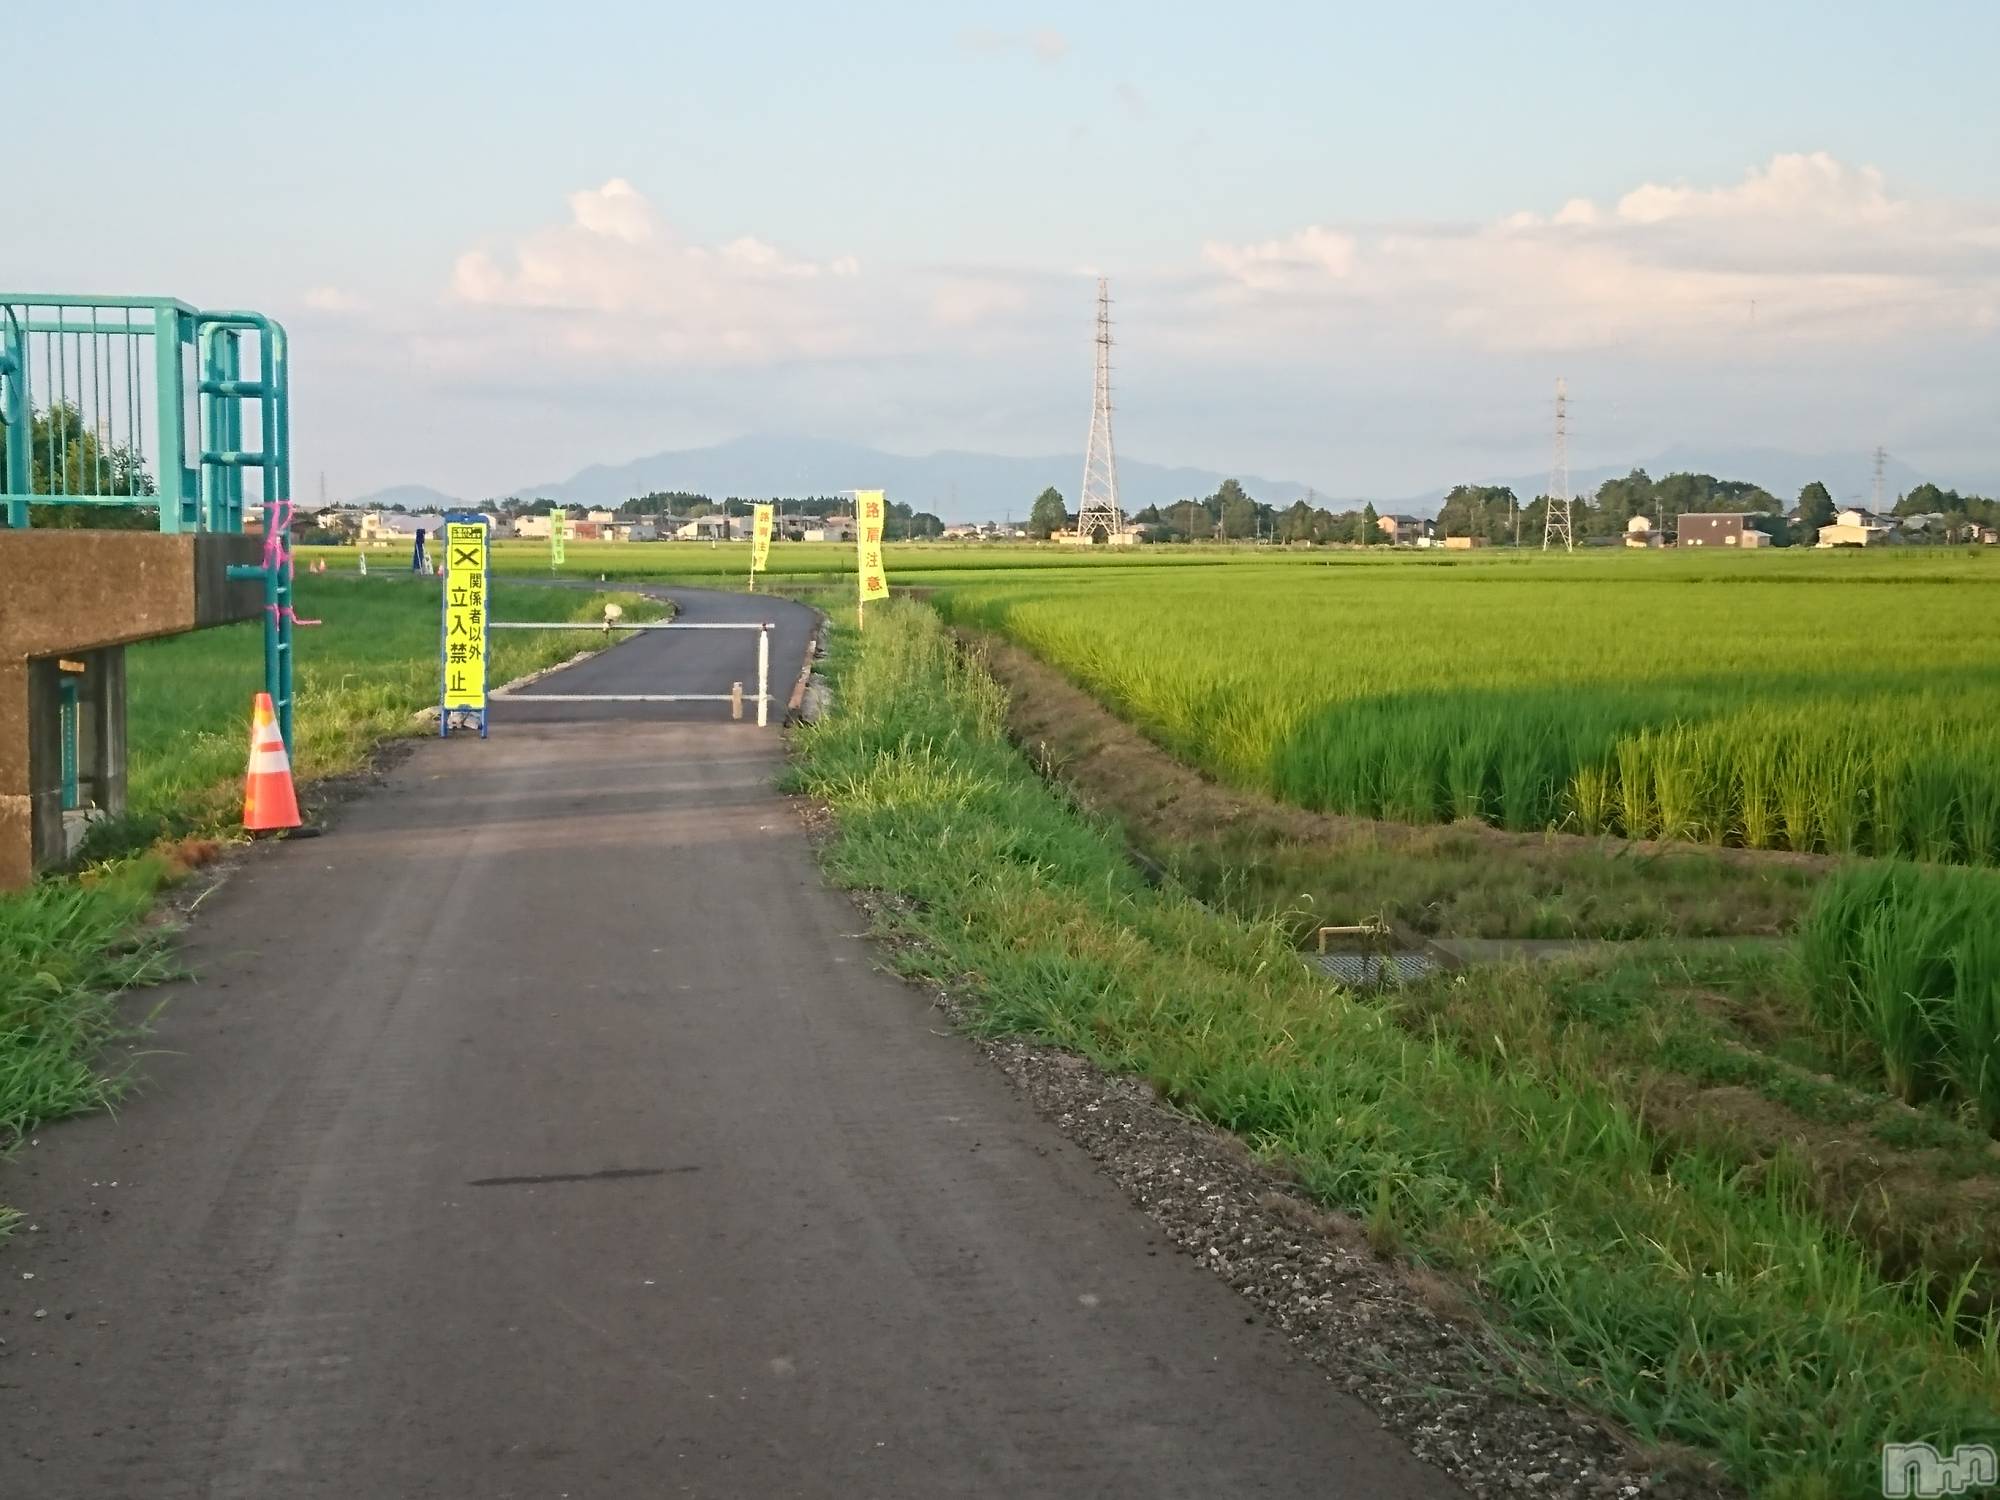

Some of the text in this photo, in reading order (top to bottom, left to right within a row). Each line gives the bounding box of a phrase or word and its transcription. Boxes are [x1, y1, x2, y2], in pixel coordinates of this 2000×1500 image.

[866, 502, 882, 591] 路肩注意
[450, 586, 468, 692] 立入禁止
[469, 573, 482, 660] 関係者以外
